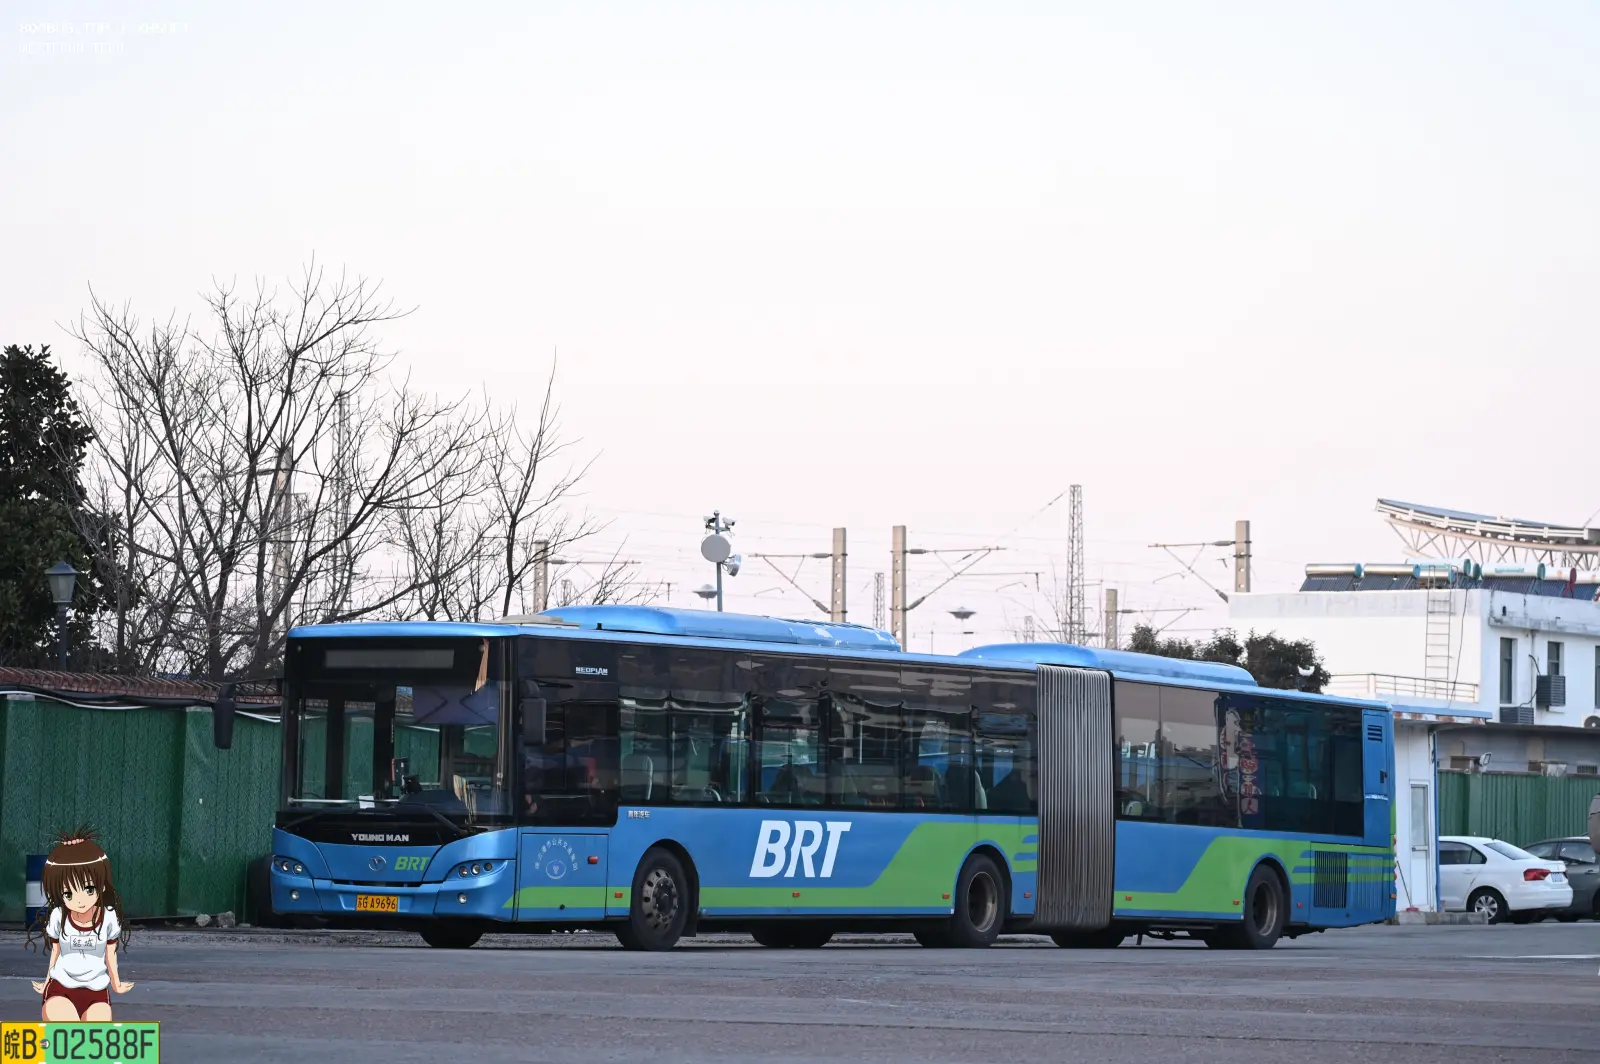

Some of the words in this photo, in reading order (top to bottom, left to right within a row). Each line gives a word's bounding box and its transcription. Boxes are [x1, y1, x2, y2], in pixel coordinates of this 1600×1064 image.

[351, 833, 384, 842] YOUNG
[386, 834, 410, 842] MAN
[749, 819, 852, 878] BRT
[394, 856, 431, 871] BRT
